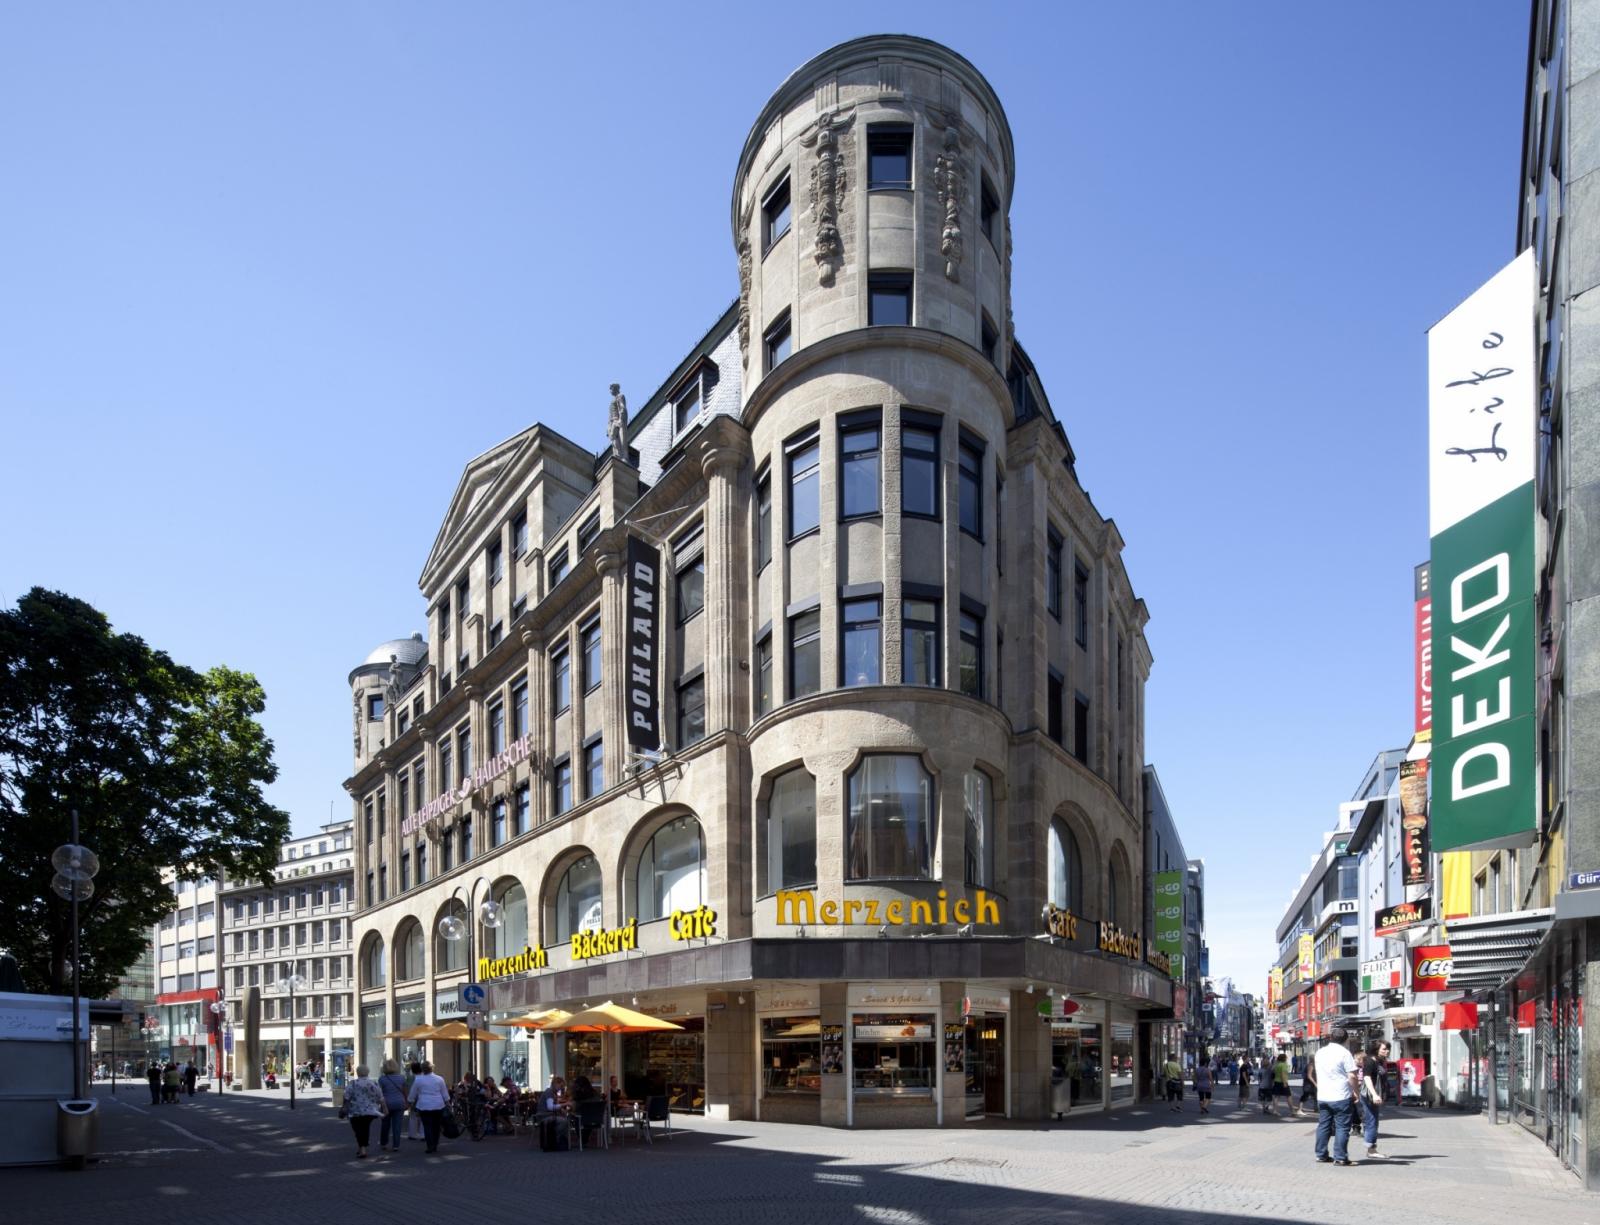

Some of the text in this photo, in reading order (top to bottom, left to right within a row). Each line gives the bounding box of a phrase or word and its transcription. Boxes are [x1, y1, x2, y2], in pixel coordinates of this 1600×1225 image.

[1445, 332, 1514, 463] Life
[632, 561, 654, 732] POHLAND
[1451, 551, 1512, 802] DEKO
[401, 734, 532, 837] ALTE LEIPZIGER HALLESCHE
[1400, 766, 1426, 776] SAMAN
[1409, 828, 1422, 875] SAMAN
[1577, 873, 1600, 885] Gür
[776, 889, 1000, 926] Merzenich
[1381, 906, 1423, 927] SAMAN
[571, 917, 638, 960] Bäckerei
[1100, 922, 1140, 960] Bäckerei
[478, 945, 549, 982] Merzenich
[1363, 959, 1396, 975] FLIRT
[1417, 958, 1452, 978] LEG
